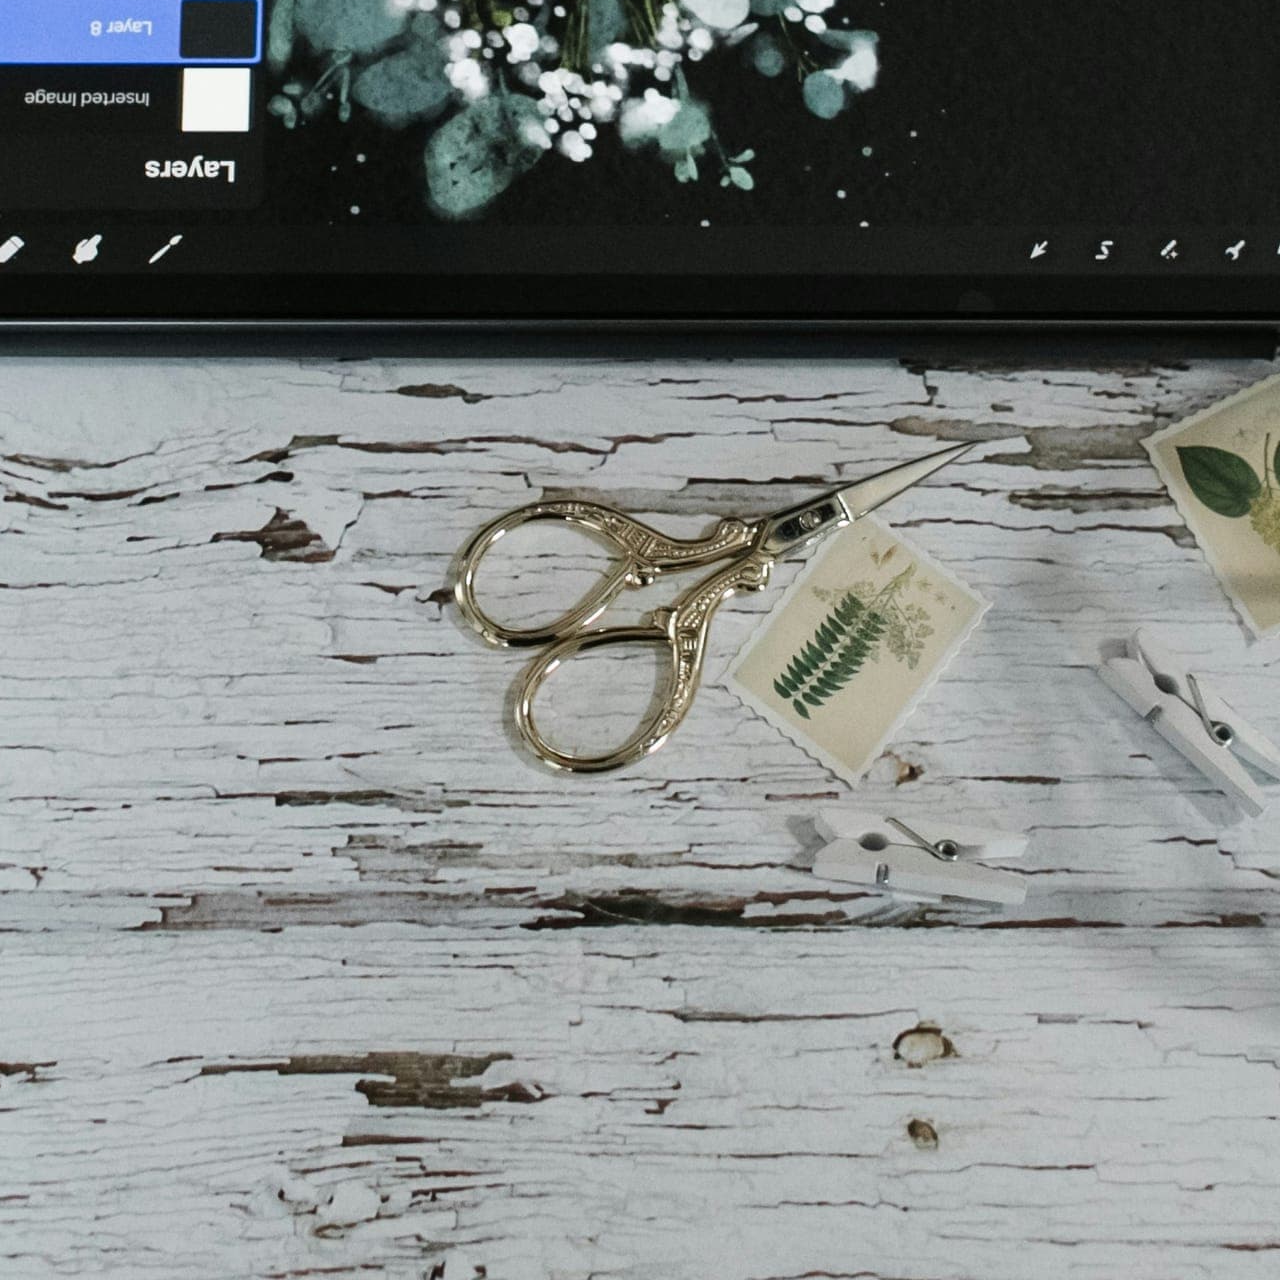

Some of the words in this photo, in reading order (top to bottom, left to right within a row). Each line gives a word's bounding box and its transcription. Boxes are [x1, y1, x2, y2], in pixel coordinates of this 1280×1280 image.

[90, 20, 103, 37] 8
[107, 17, 153, 36] Layer
[24, 88, 77, 107] Image
[80, 91, 150, 108] Inserted
[144, 155, 236, 182] Layers
